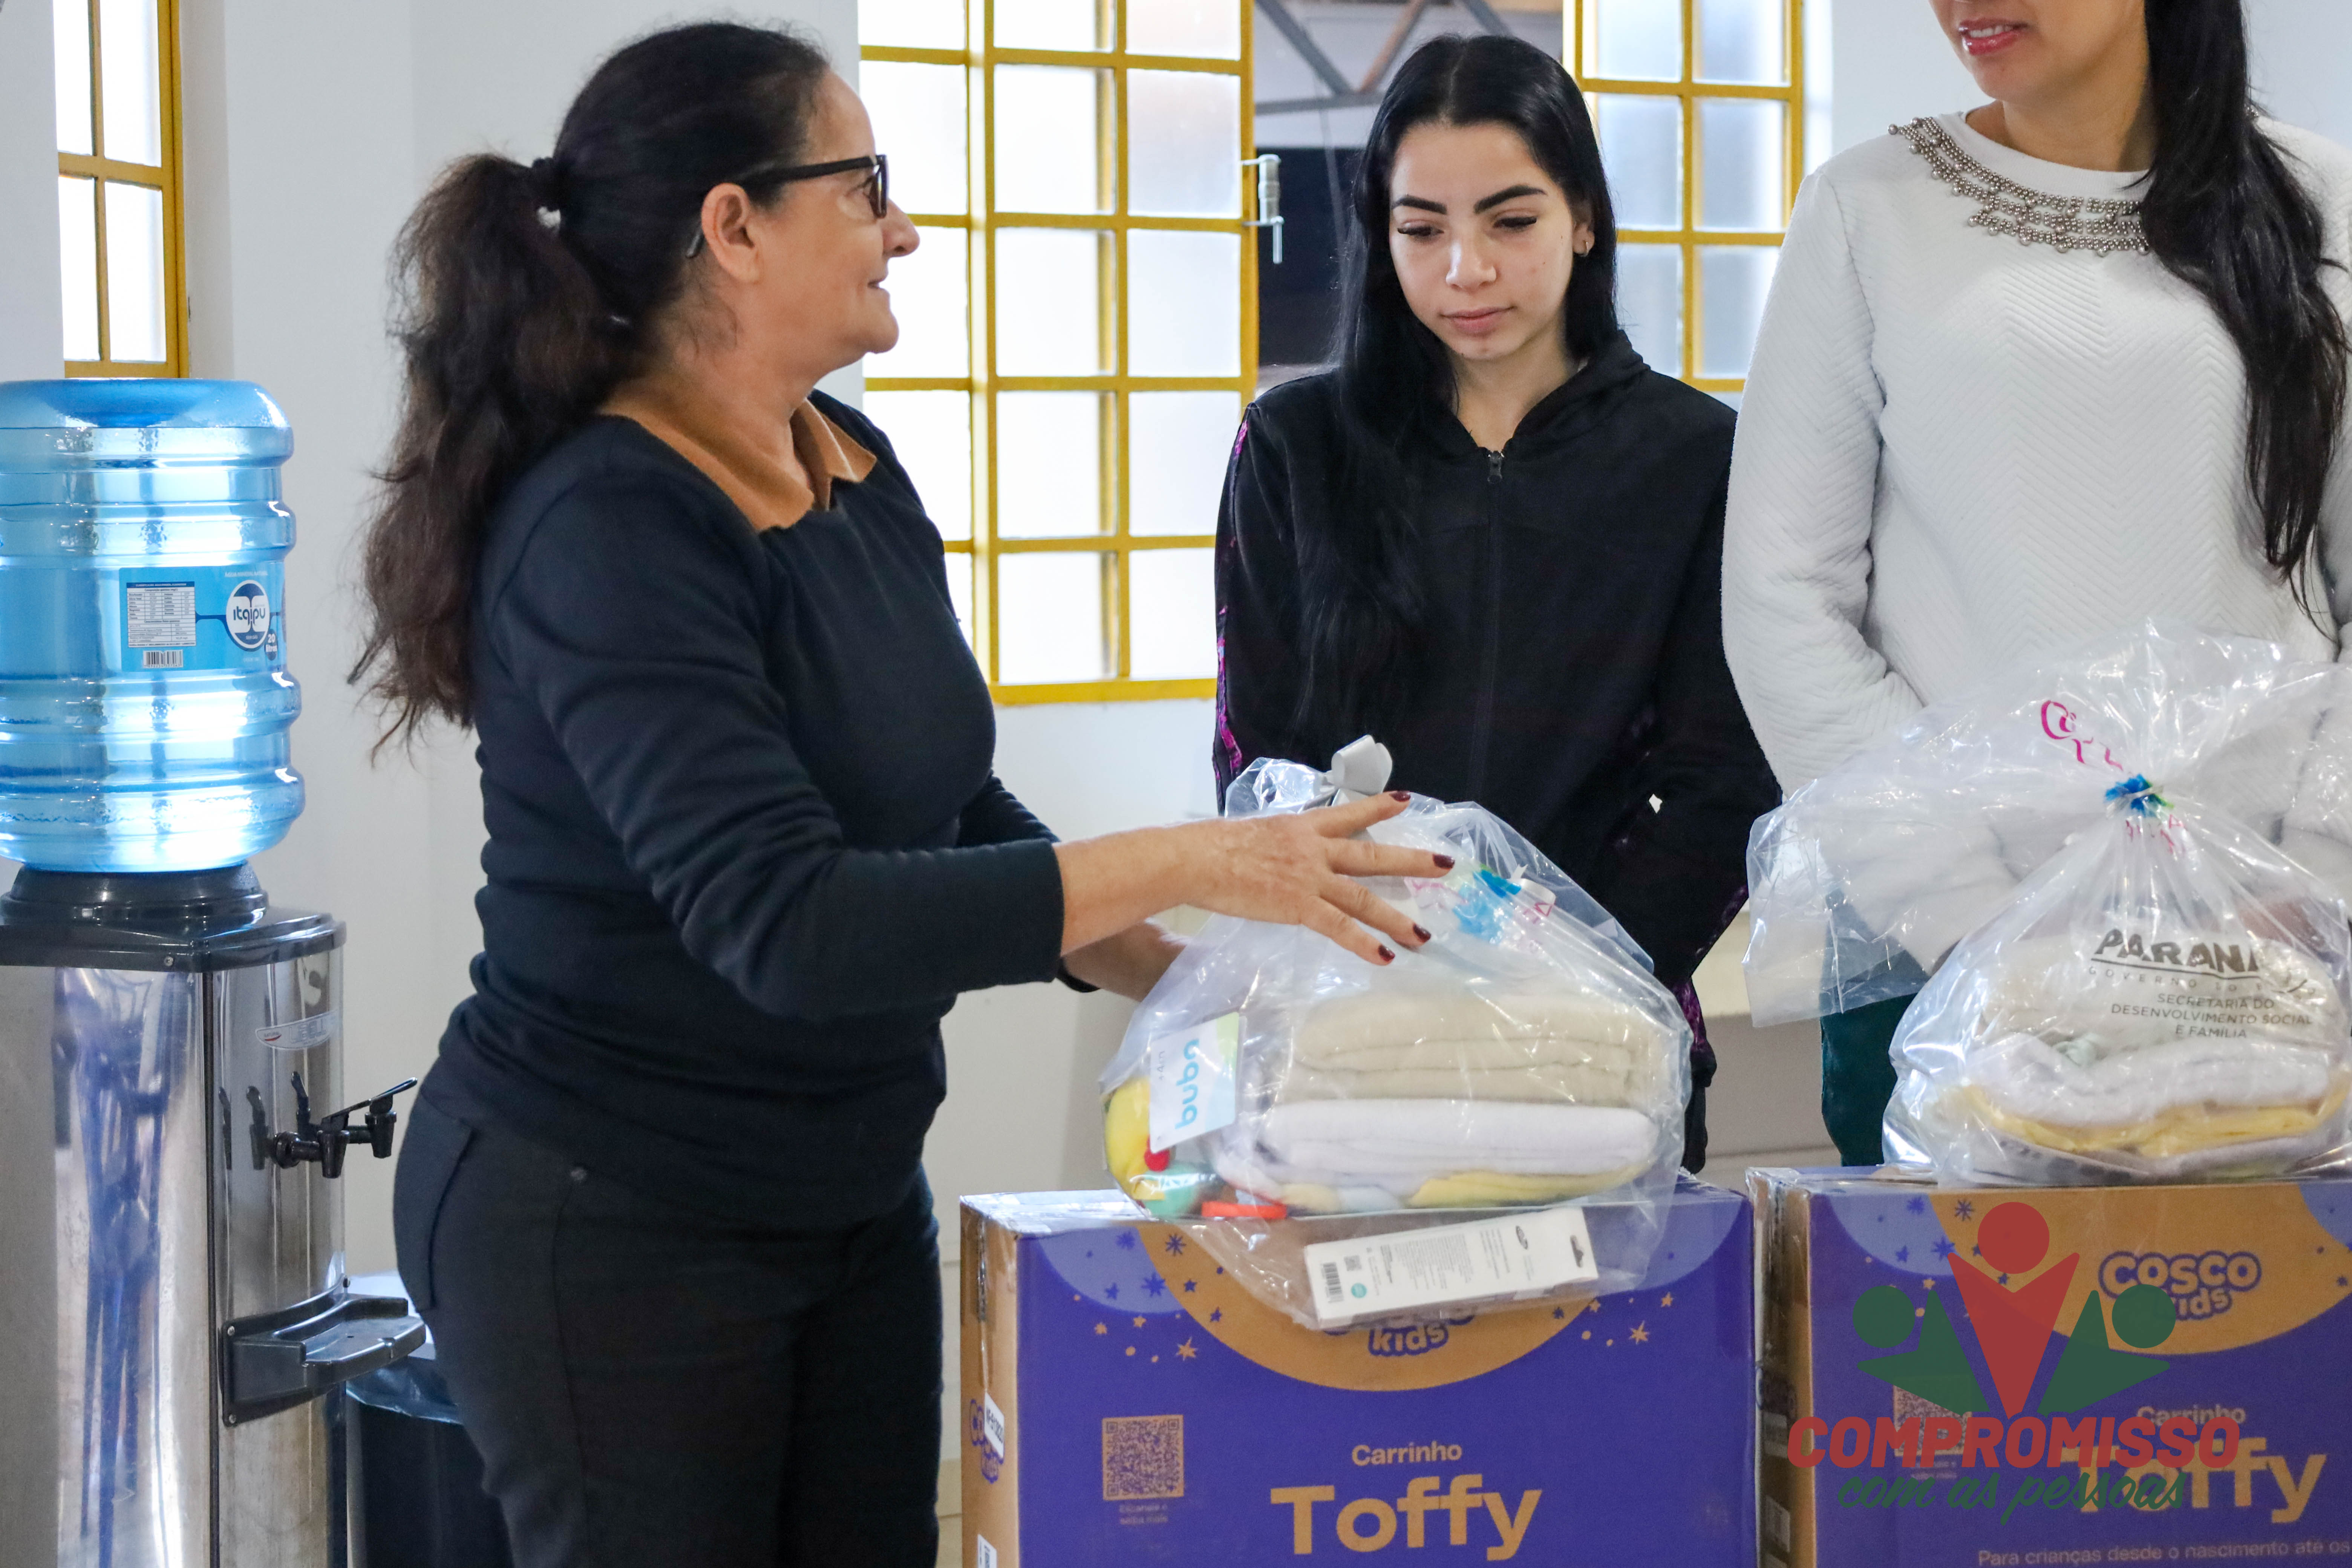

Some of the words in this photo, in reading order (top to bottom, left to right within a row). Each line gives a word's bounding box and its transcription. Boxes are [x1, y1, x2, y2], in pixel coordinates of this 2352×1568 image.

[265, 644, 278, 652] litros
[268, 634, 276, 643] 20
[2089, 966, 2197, 988] GOVERNO
[2157, 993, 2248, 1009] SECRETARIA
[2253, 998, 2274, 1009] DO
[2112, 1003, 2257, 1024] DESENVOLVIMENTO
[2262, 1014, 2313, 1026] SOCIAL
[2176, 1024, 2184, 1035] E
[2098, 1250, 2261, 1298] COSCO
[1368, 1324, 1449, 1357] kids
[2136, 1404, 2246, 1427] Carrinho
[1351, 1441, 1462, 1466] Carrinho
[2060, 1436, 2327, 1524] Toffy
[1270, 1473, 1542, 1562] Toffy
[1978, 1550, 2020, 1566] Para
[2024, 1548, 2102, 1568] crianças
[2107, 1545, 2163, 1562] desde
[2168, 1547, 2180, 1559] o
[2185, 1541, 2289, 1559] nascimento
[2295, 1538, 2324, 1555] até
[2329, 1541, 2350, 1554] os
